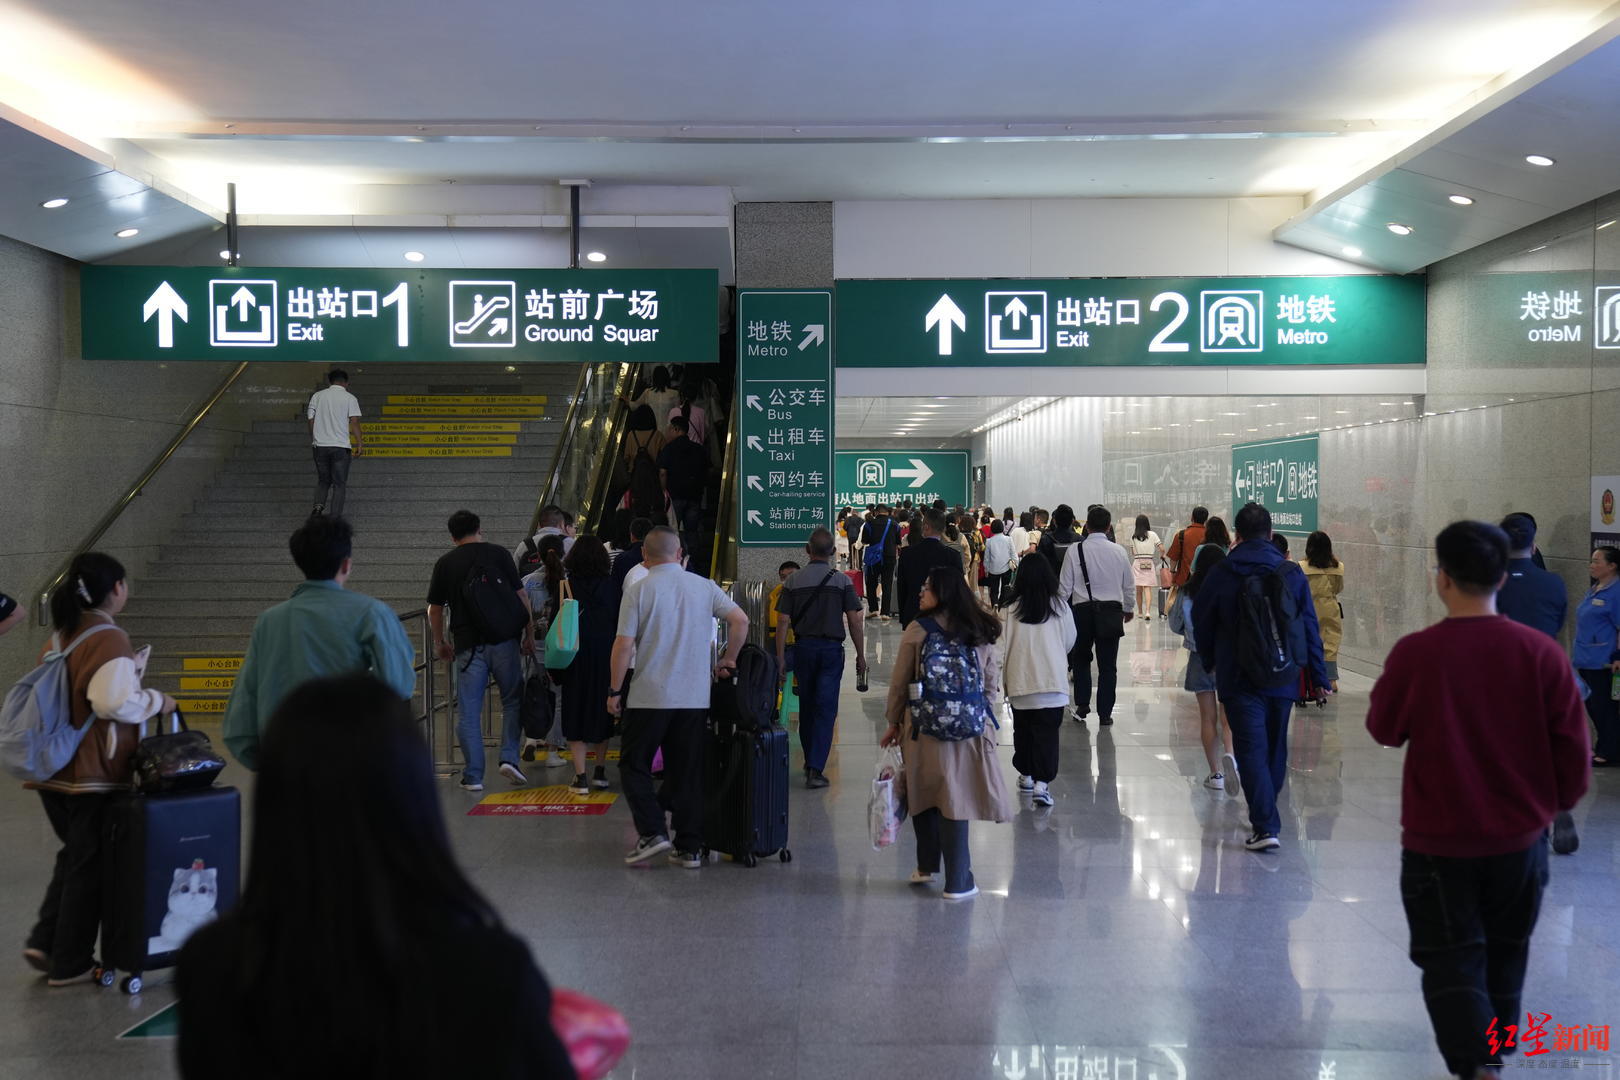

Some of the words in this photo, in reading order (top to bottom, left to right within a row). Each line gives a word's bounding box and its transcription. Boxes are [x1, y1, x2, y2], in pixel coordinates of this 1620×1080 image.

[525, 288, 659, 320] 站前广场
[1276, 294, 1336, 323] 地铁
[288, 287, 378, 319] 出站口
[382, 282, 409, 347] 1
[1056, 297, 1140, 327] 出站口
[1148, 291, 1189, 352] 2
[288, 323, 324, 341] Exit
[525, 324, 593, 342] Ground
[603, 324, 659, 346] Squar
[747, 320, 792, 341] 地铁
[1056, 331, 1090, 347] Exit
[1277, 328, 1328, 344] Metro
[748, 345, 788, 356] Metro
[768, 387, 826, 406] 公交车
[767, 409, 792, 420] Bus
[768, 427, 825, 446] 出租车
[768, 450, 795, 461] Taxi
[769, 471, 825, 488] 网约车
[1256, 460, 1276, 488] 出站口
[1276, 458, 1284, 503] 2
[1298, 461, 1318, 499] 地铁
[769, 507, 824, 520] 站前广场
